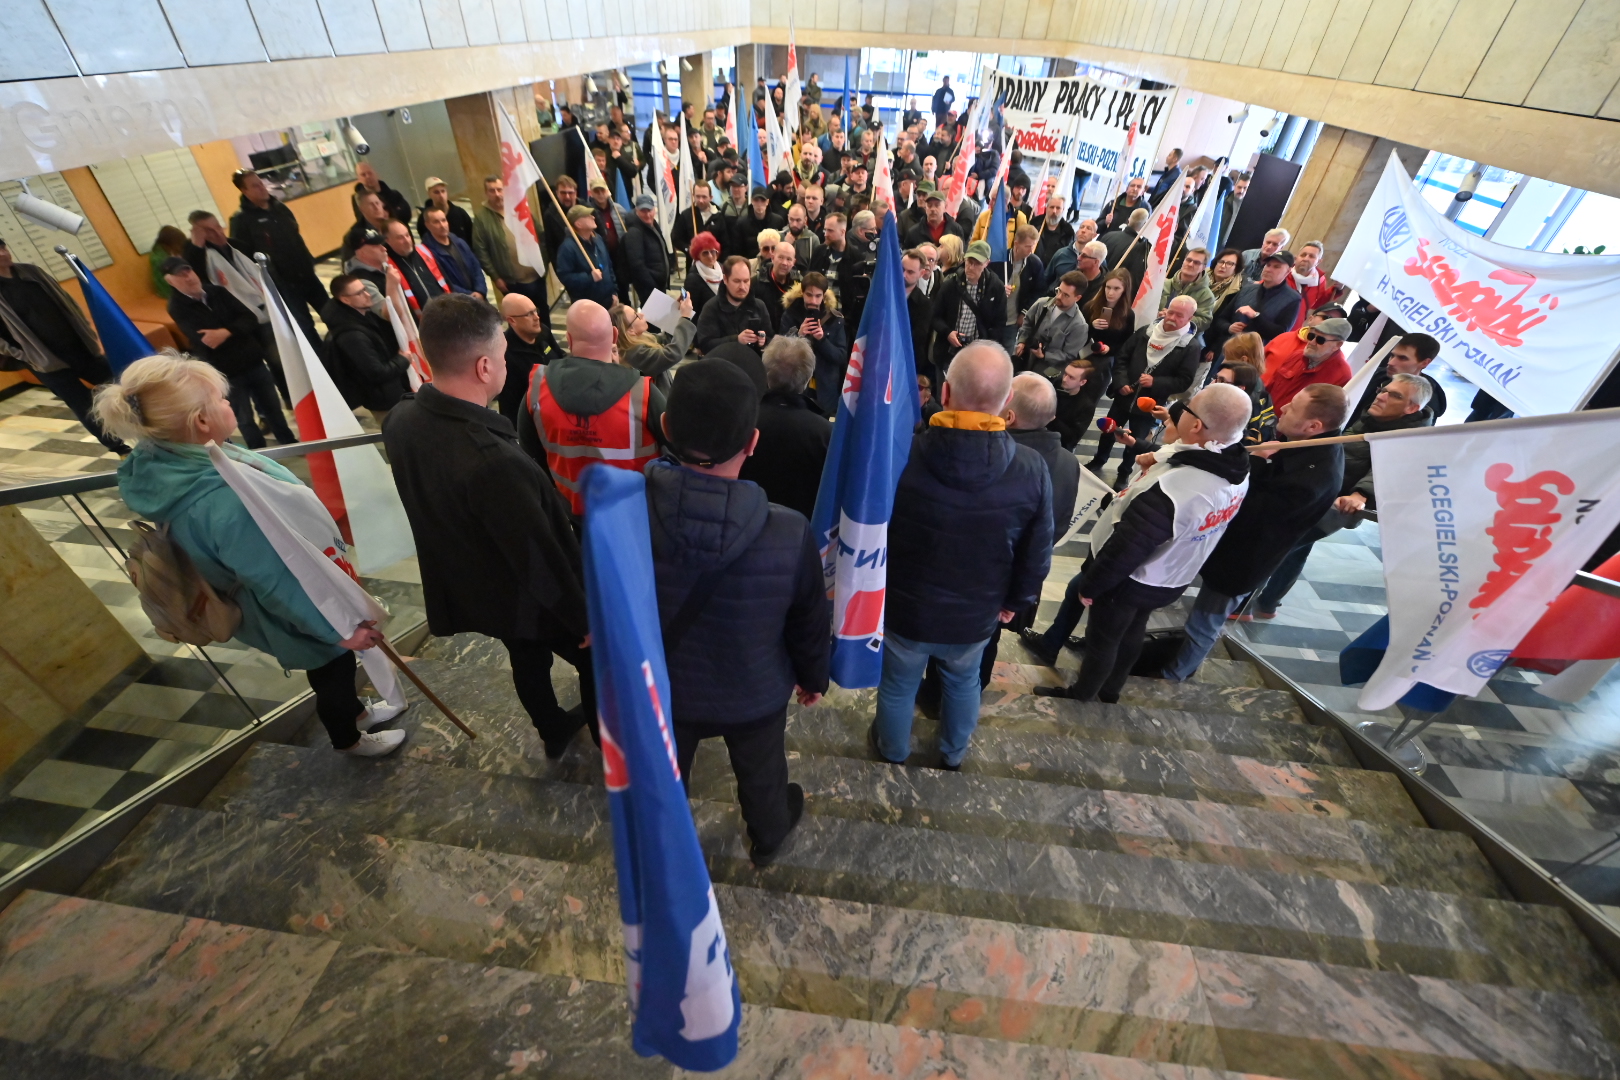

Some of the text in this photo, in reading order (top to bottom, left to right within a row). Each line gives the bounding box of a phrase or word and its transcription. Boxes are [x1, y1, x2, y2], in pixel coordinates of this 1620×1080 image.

[1053, 80, 1107, 121] PRACY
[1104, 90, 1119, 125] I
[1114, 91, 1167, 136] PŁCY
